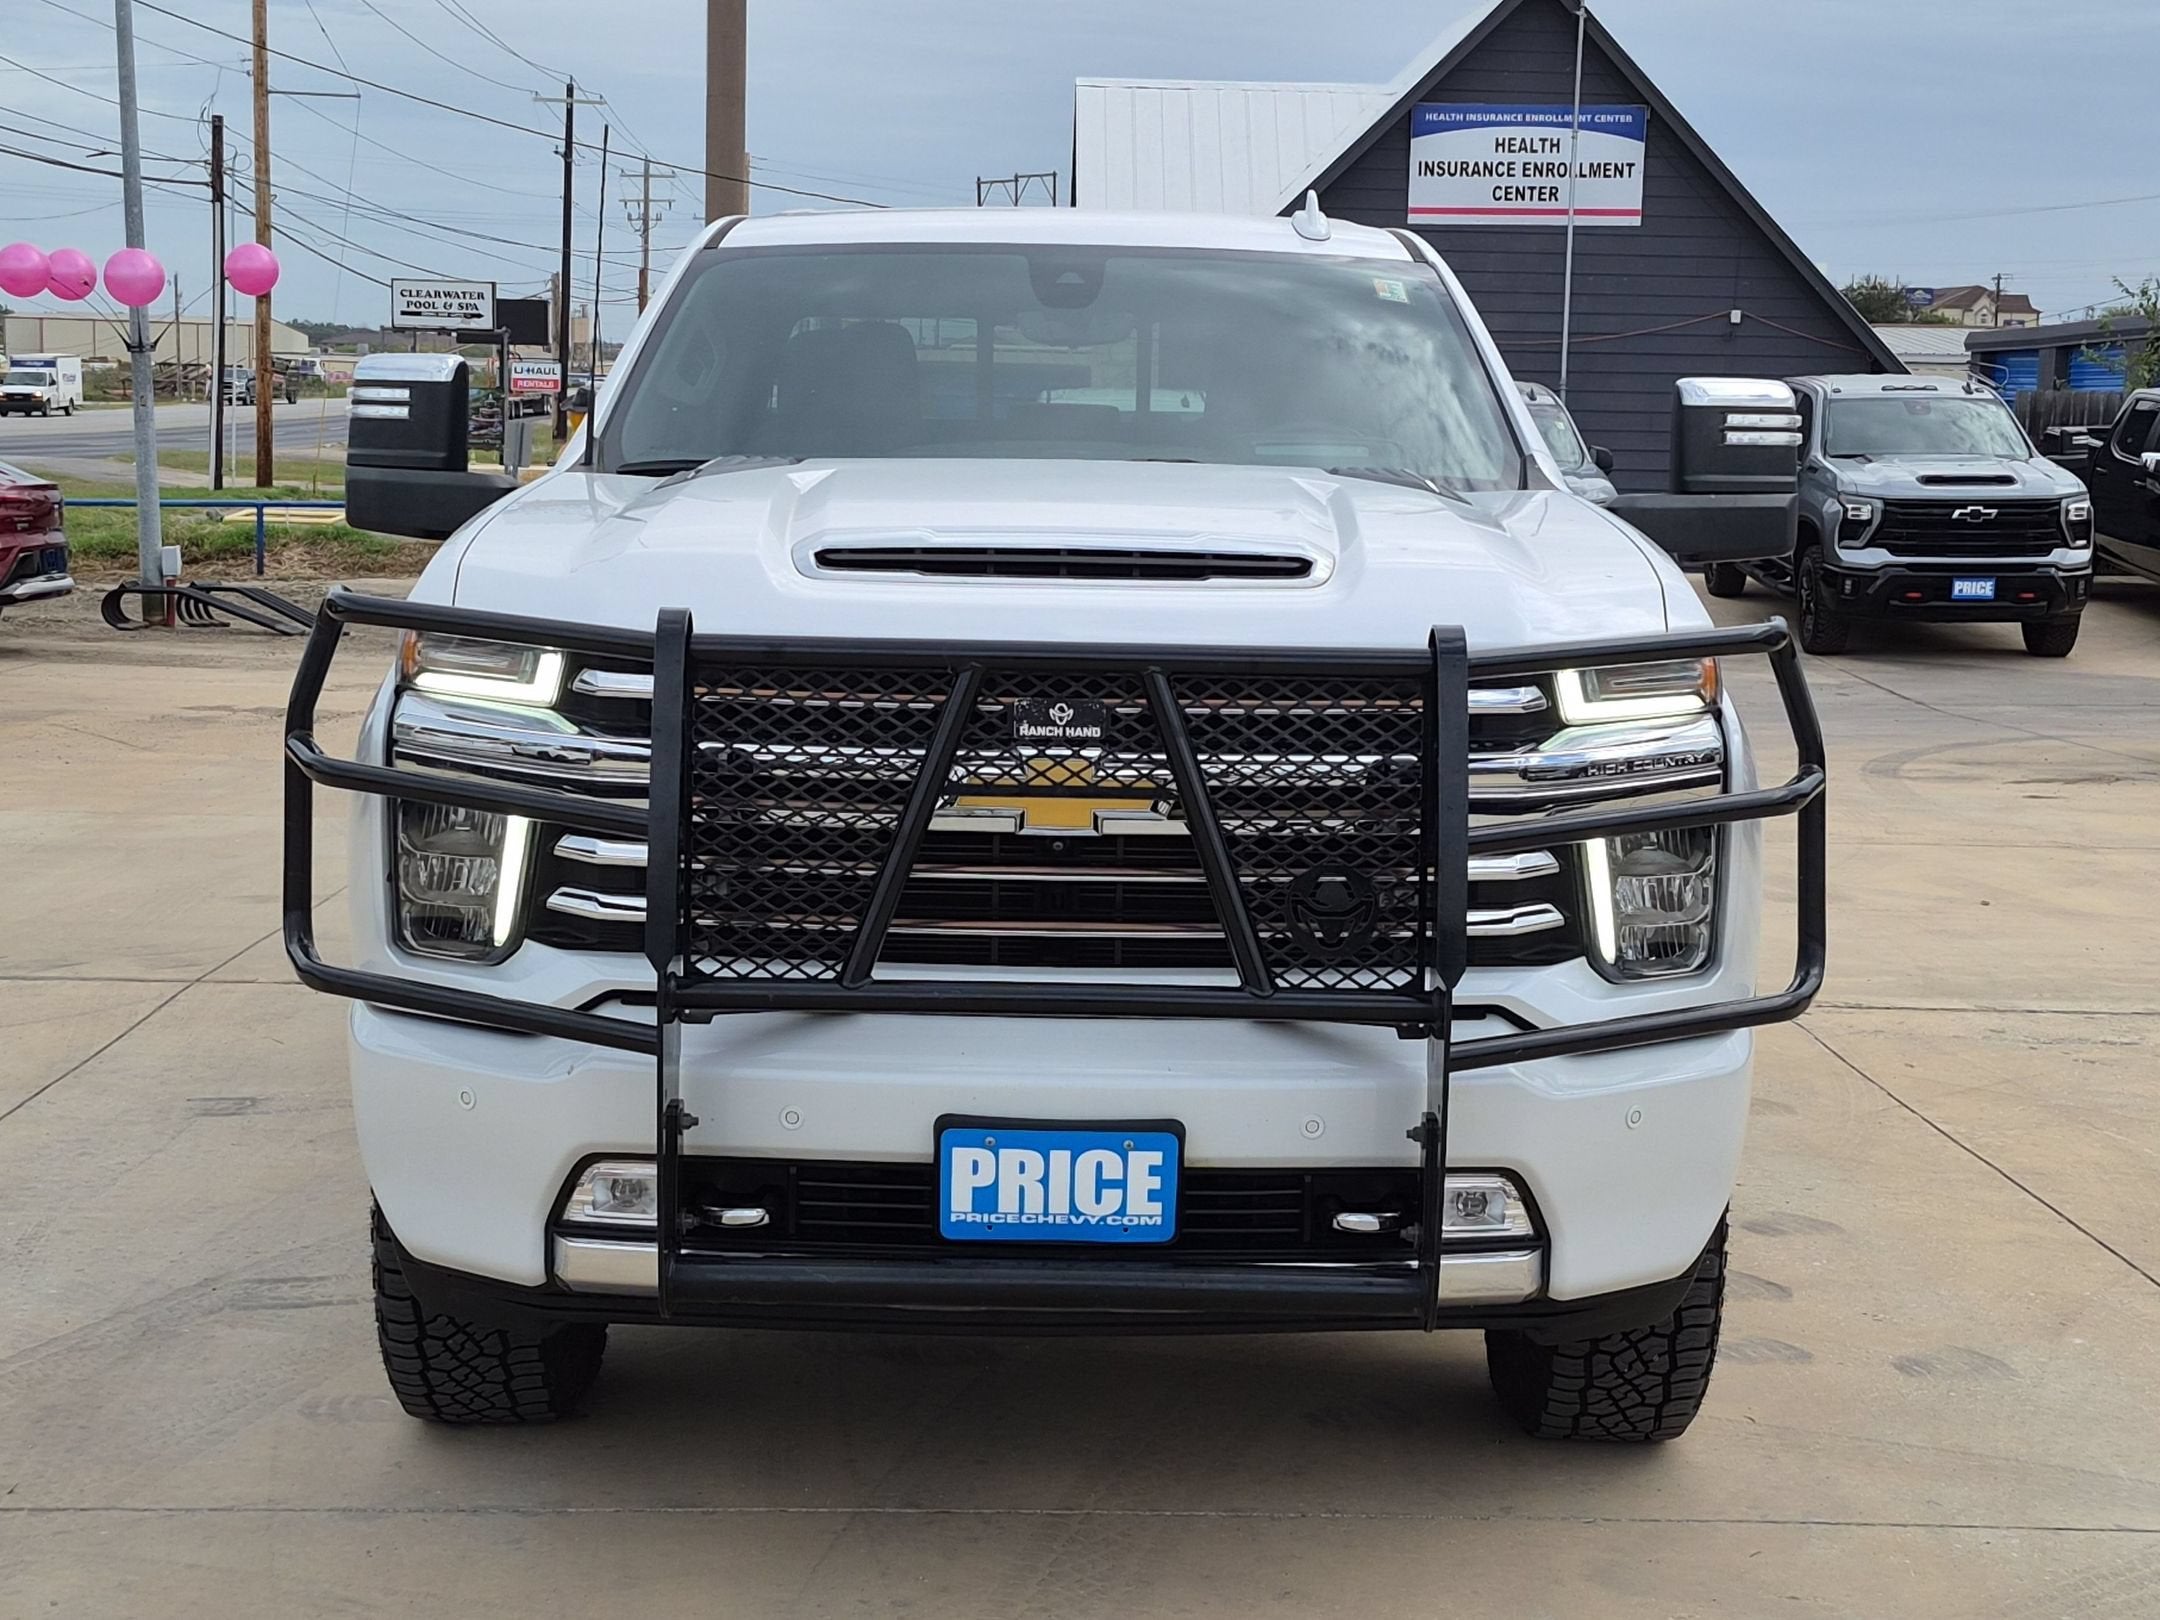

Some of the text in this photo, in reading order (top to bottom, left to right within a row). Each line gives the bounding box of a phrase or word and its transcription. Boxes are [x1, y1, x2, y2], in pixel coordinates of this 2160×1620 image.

[1425, 112, 1633, 123] HEALTH INSURANCE ENROLLMNT CENTER
[1494, 137, 1561, 154] HEALTH
[1418, 160, 1516, 178] INSURANCE
[1492, 185, 1560, 202] CENTER
[400, 289, 485, 300] CLEARWATER
[406, 300, 479, 311] POOL & SPA
[517, 380, 555, 388] RENTALS
[1954, 581, 1994, 596] PRICE
[1019, 726, 1101, 737] RANCH HAND
[1632, 753, 1706, 772] COUNTRY
[950, 1147, 1163, 1216] PRICE
[950, 1213, 1162, 1225] PRICECHEVY.COM
